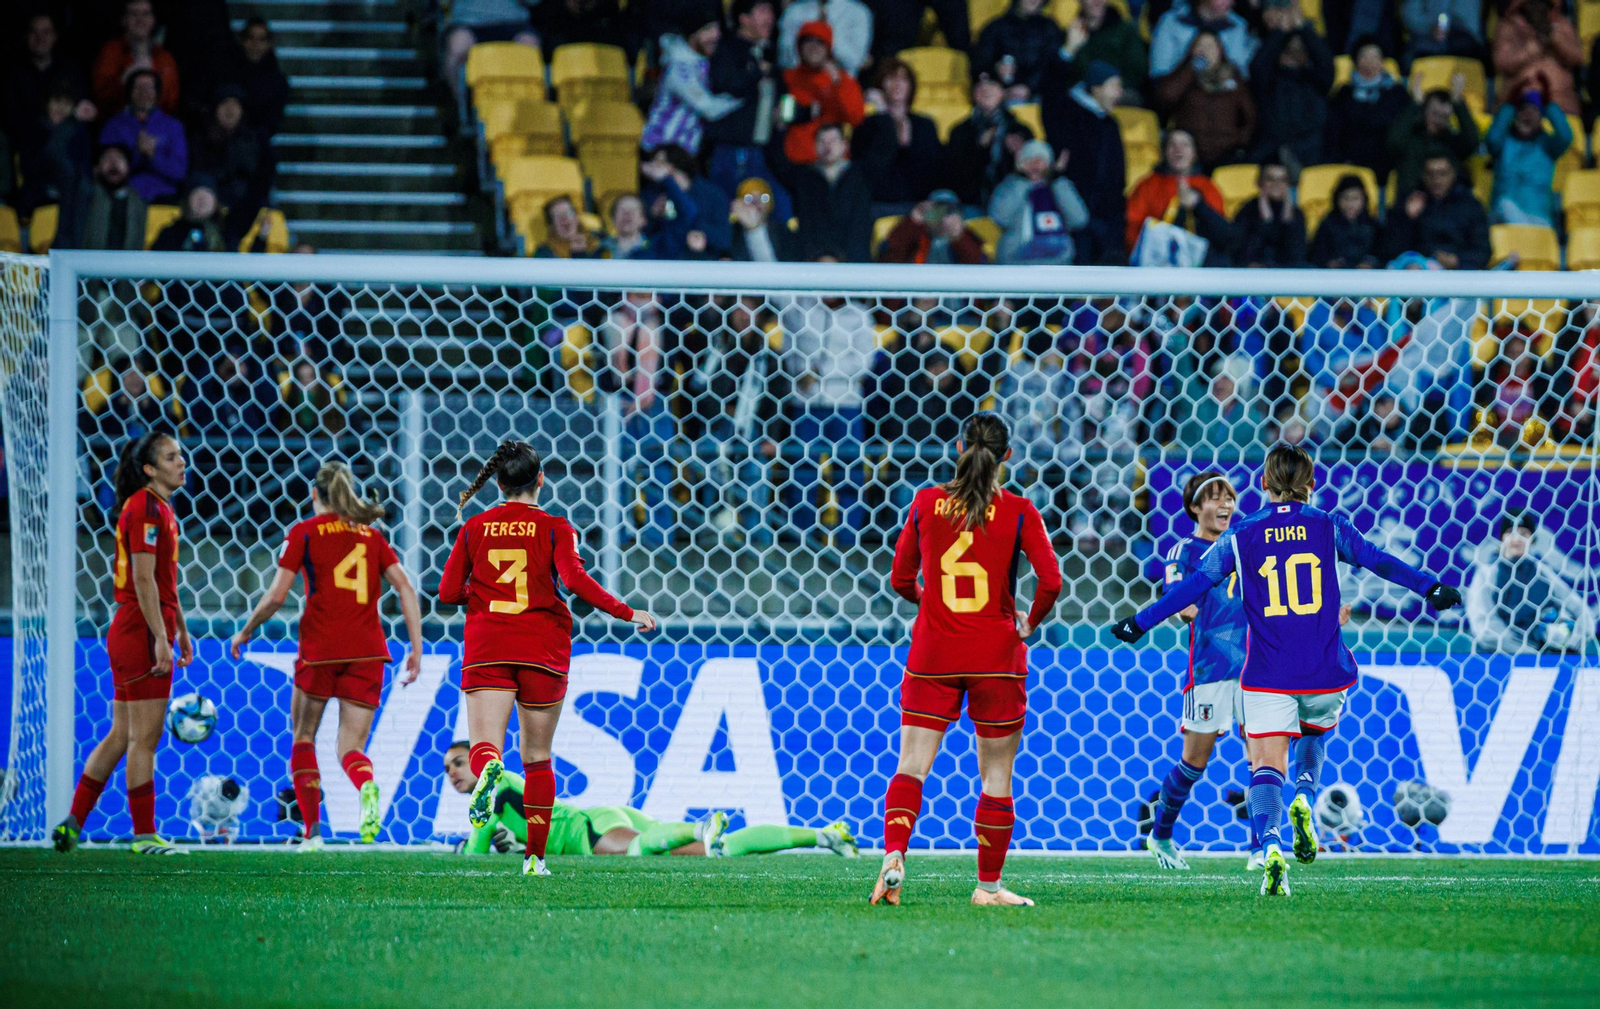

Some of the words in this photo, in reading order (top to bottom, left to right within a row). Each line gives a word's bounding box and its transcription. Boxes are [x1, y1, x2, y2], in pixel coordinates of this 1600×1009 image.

[483, 521, 536, 537] TERESA
[934, 498, 996, 521] AITA
[1264, 525, 1307, 544] FUKA
[333, 543, 368, 604] 4
[488, 549, 529, 614] 3
[940, 531, 989, 612] 6
[1258, 553, 1323, 617] 10
